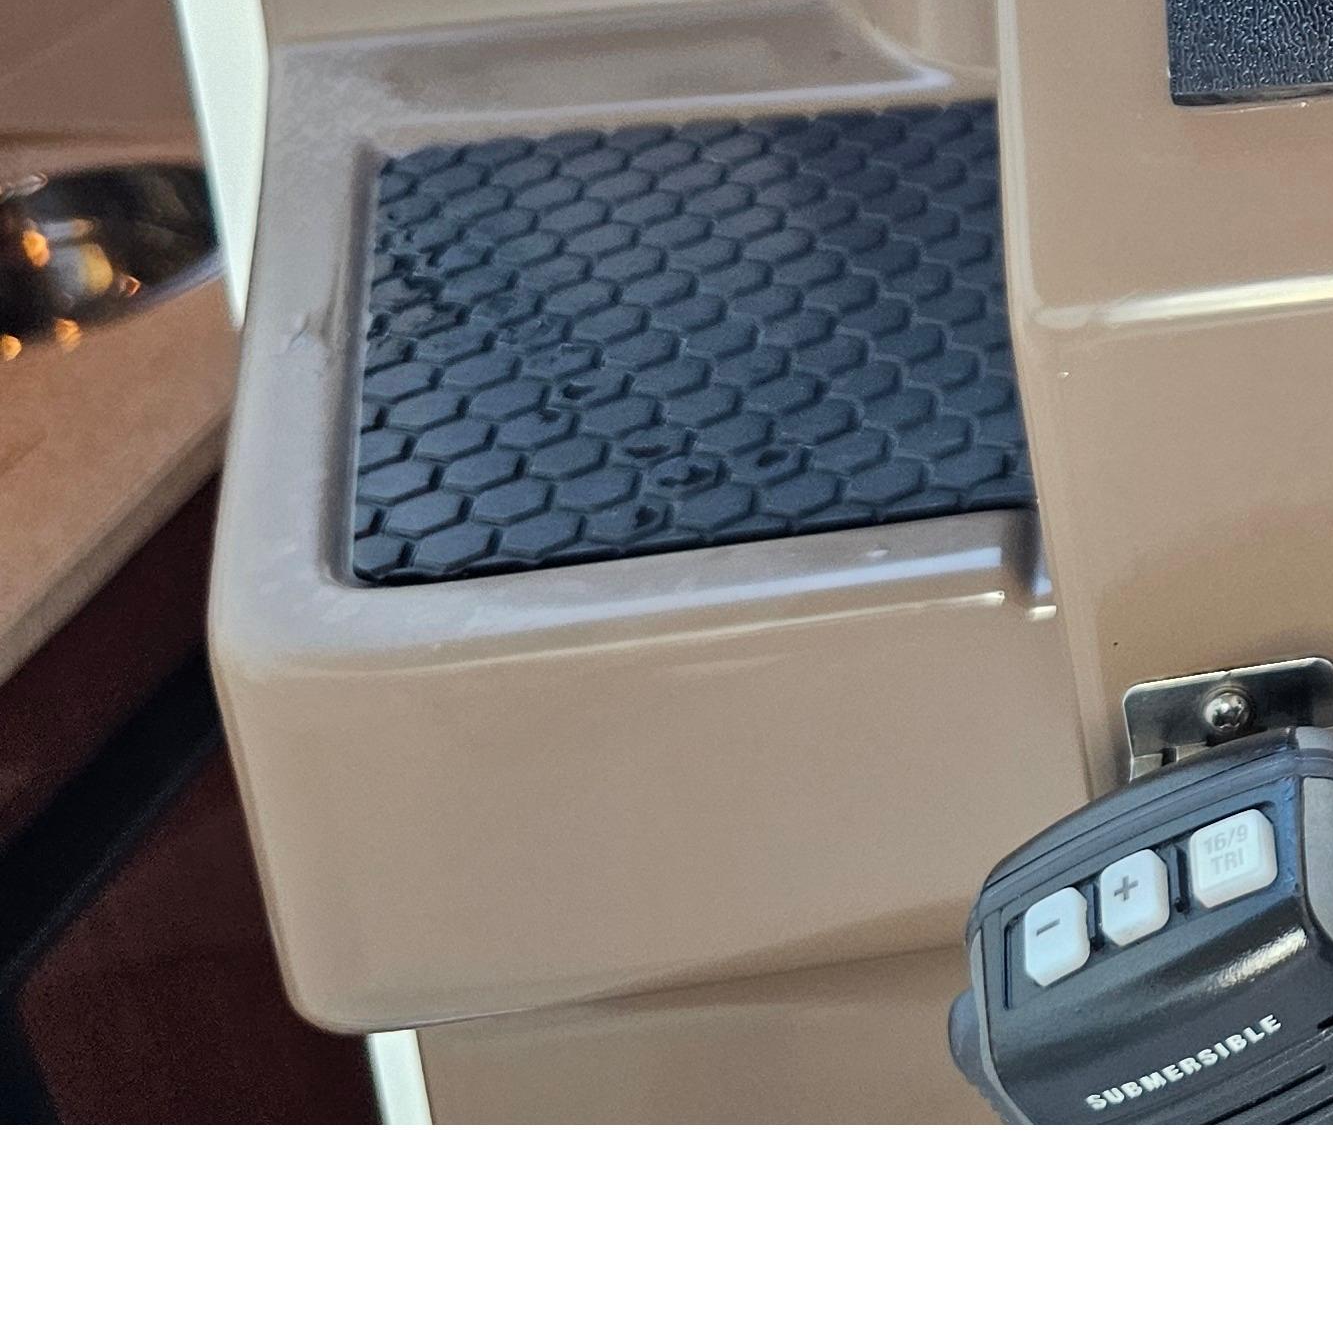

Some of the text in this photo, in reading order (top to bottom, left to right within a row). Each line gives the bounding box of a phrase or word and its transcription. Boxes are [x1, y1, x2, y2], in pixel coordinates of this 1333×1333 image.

[1204, 824, 1249, 855] 16/9
[1211, 847, 1245, 876] TRI
[1085, 1014, 1282, 1111] SUBMERSIBLE
